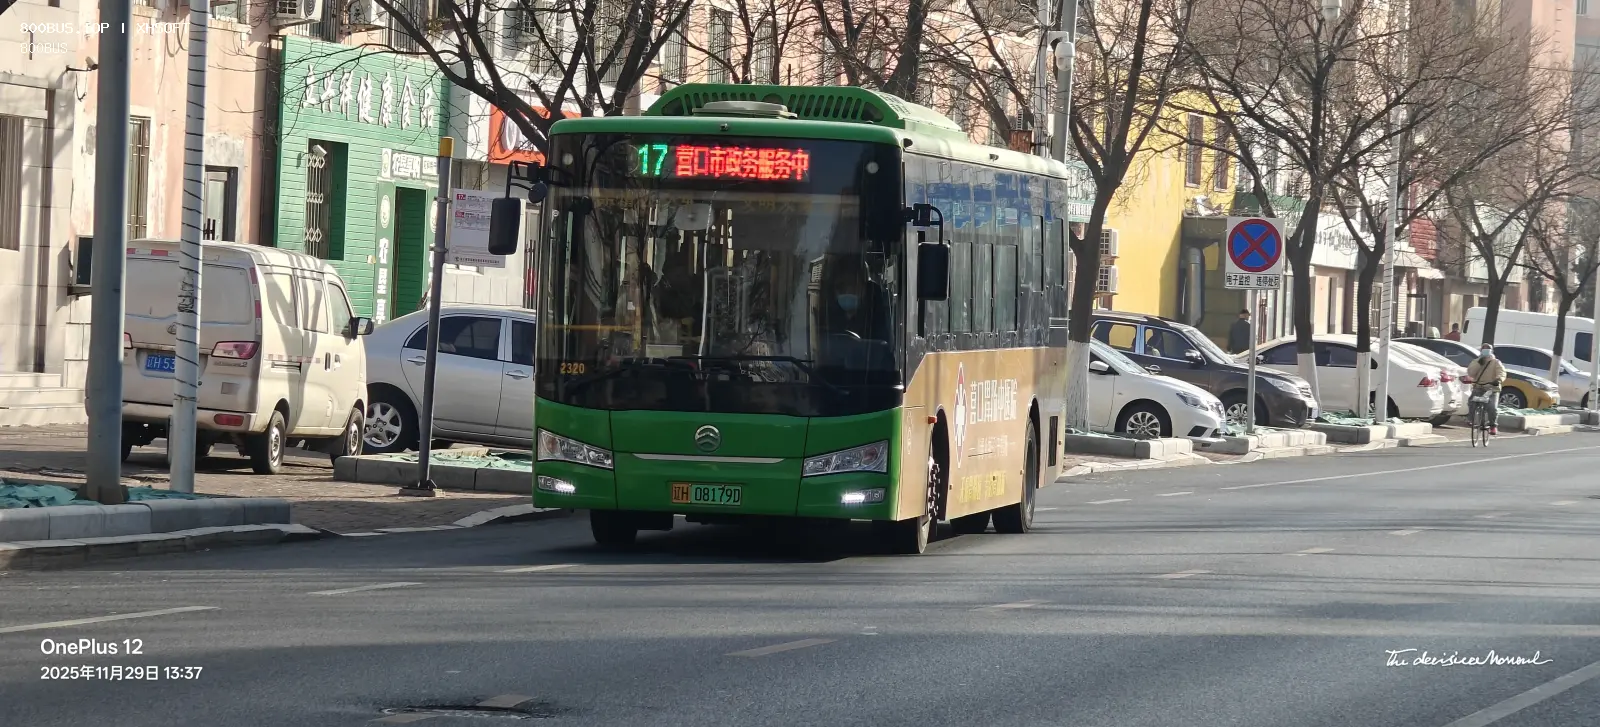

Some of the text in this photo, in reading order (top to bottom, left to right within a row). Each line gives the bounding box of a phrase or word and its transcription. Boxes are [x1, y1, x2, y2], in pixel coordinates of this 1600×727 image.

[638, 144, 810, 180] 17 营口市政务服务中
[1226, 274, 1280, 288] 电子监控 违停处罚
[560, 363, 586, 375] 2320
[673, 485, 741, 504] 辽H 08179D
